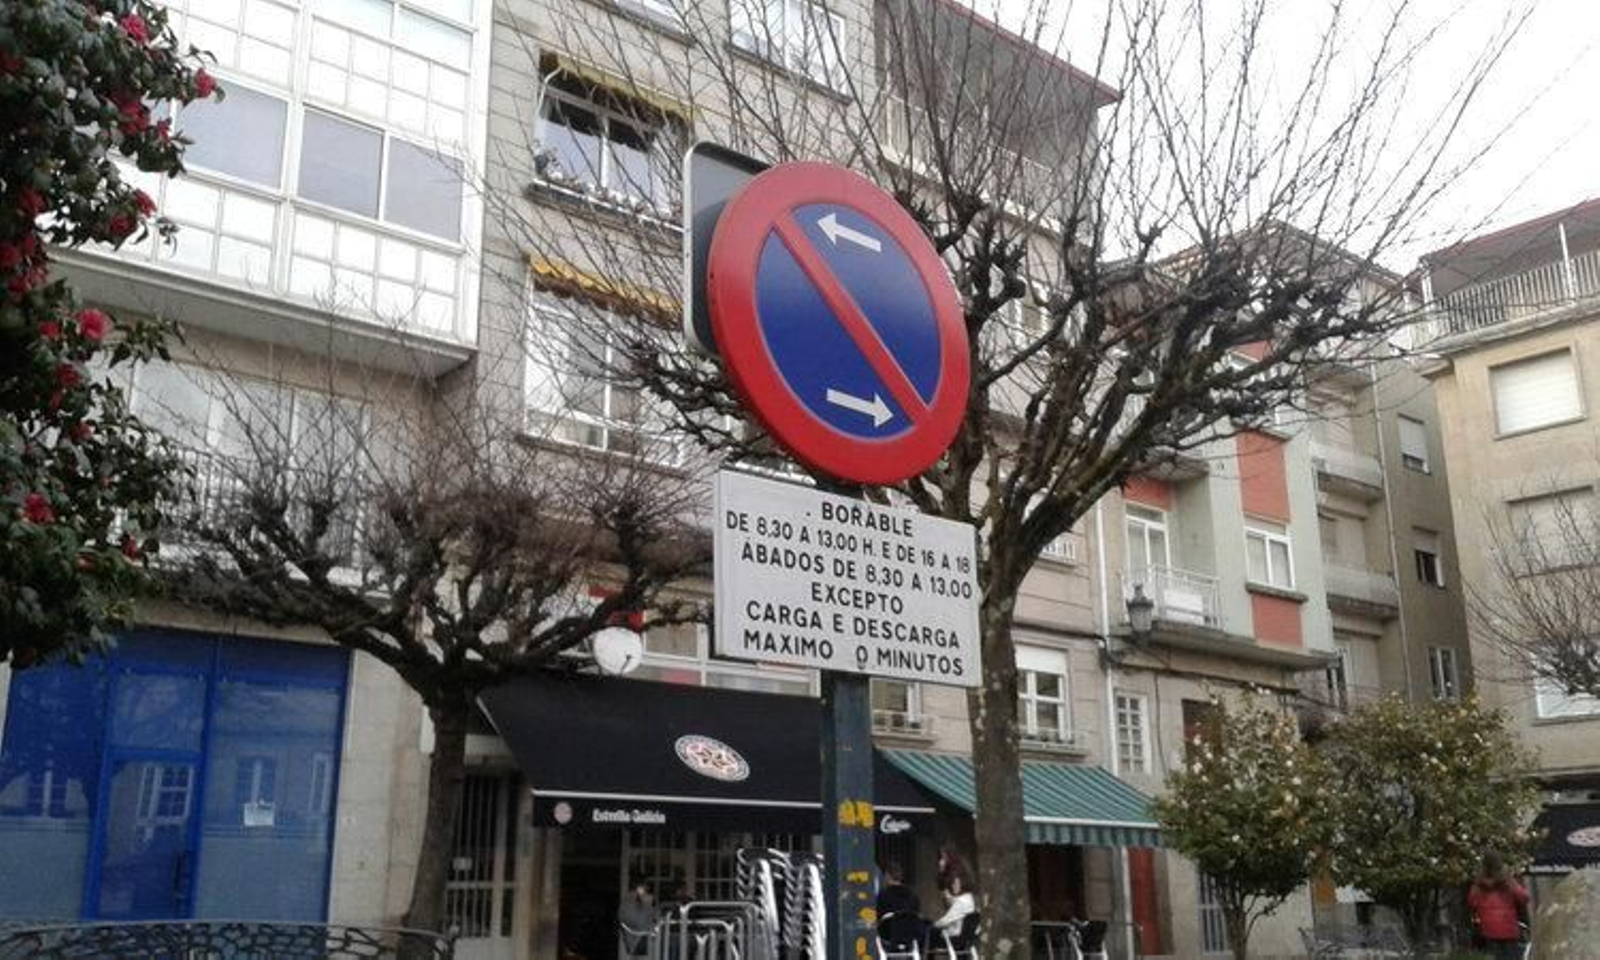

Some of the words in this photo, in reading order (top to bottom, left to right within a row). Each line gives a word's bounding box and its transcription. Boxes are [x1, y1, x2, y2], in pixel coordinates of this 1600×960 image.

[822, 502, 913, 537] BORABLE
[726, 510, 749, 532] DE
[799, 526, 811, 544] A
[863, 538, 877, 557] H.
[881, 541, 891, 559] E
[896, 544, 916, 563] DE
[921, 549, 935, 568] 16
[941, 553, 952, 571] A
[956, 556, 971, 574] 18
[833, 558, 857, 580] DE
[912, 572, 922, 592] A
[811, 581, 904, 615] EXCEPTO
[746, 600, 823, 631] CARGA
[833, 613, 844, 634] E
[853, 616, 960, 649] DESCARGA
[743, 628, 833, 660] MAXIMO
[877, 646, 963, 676] MINUTOS
